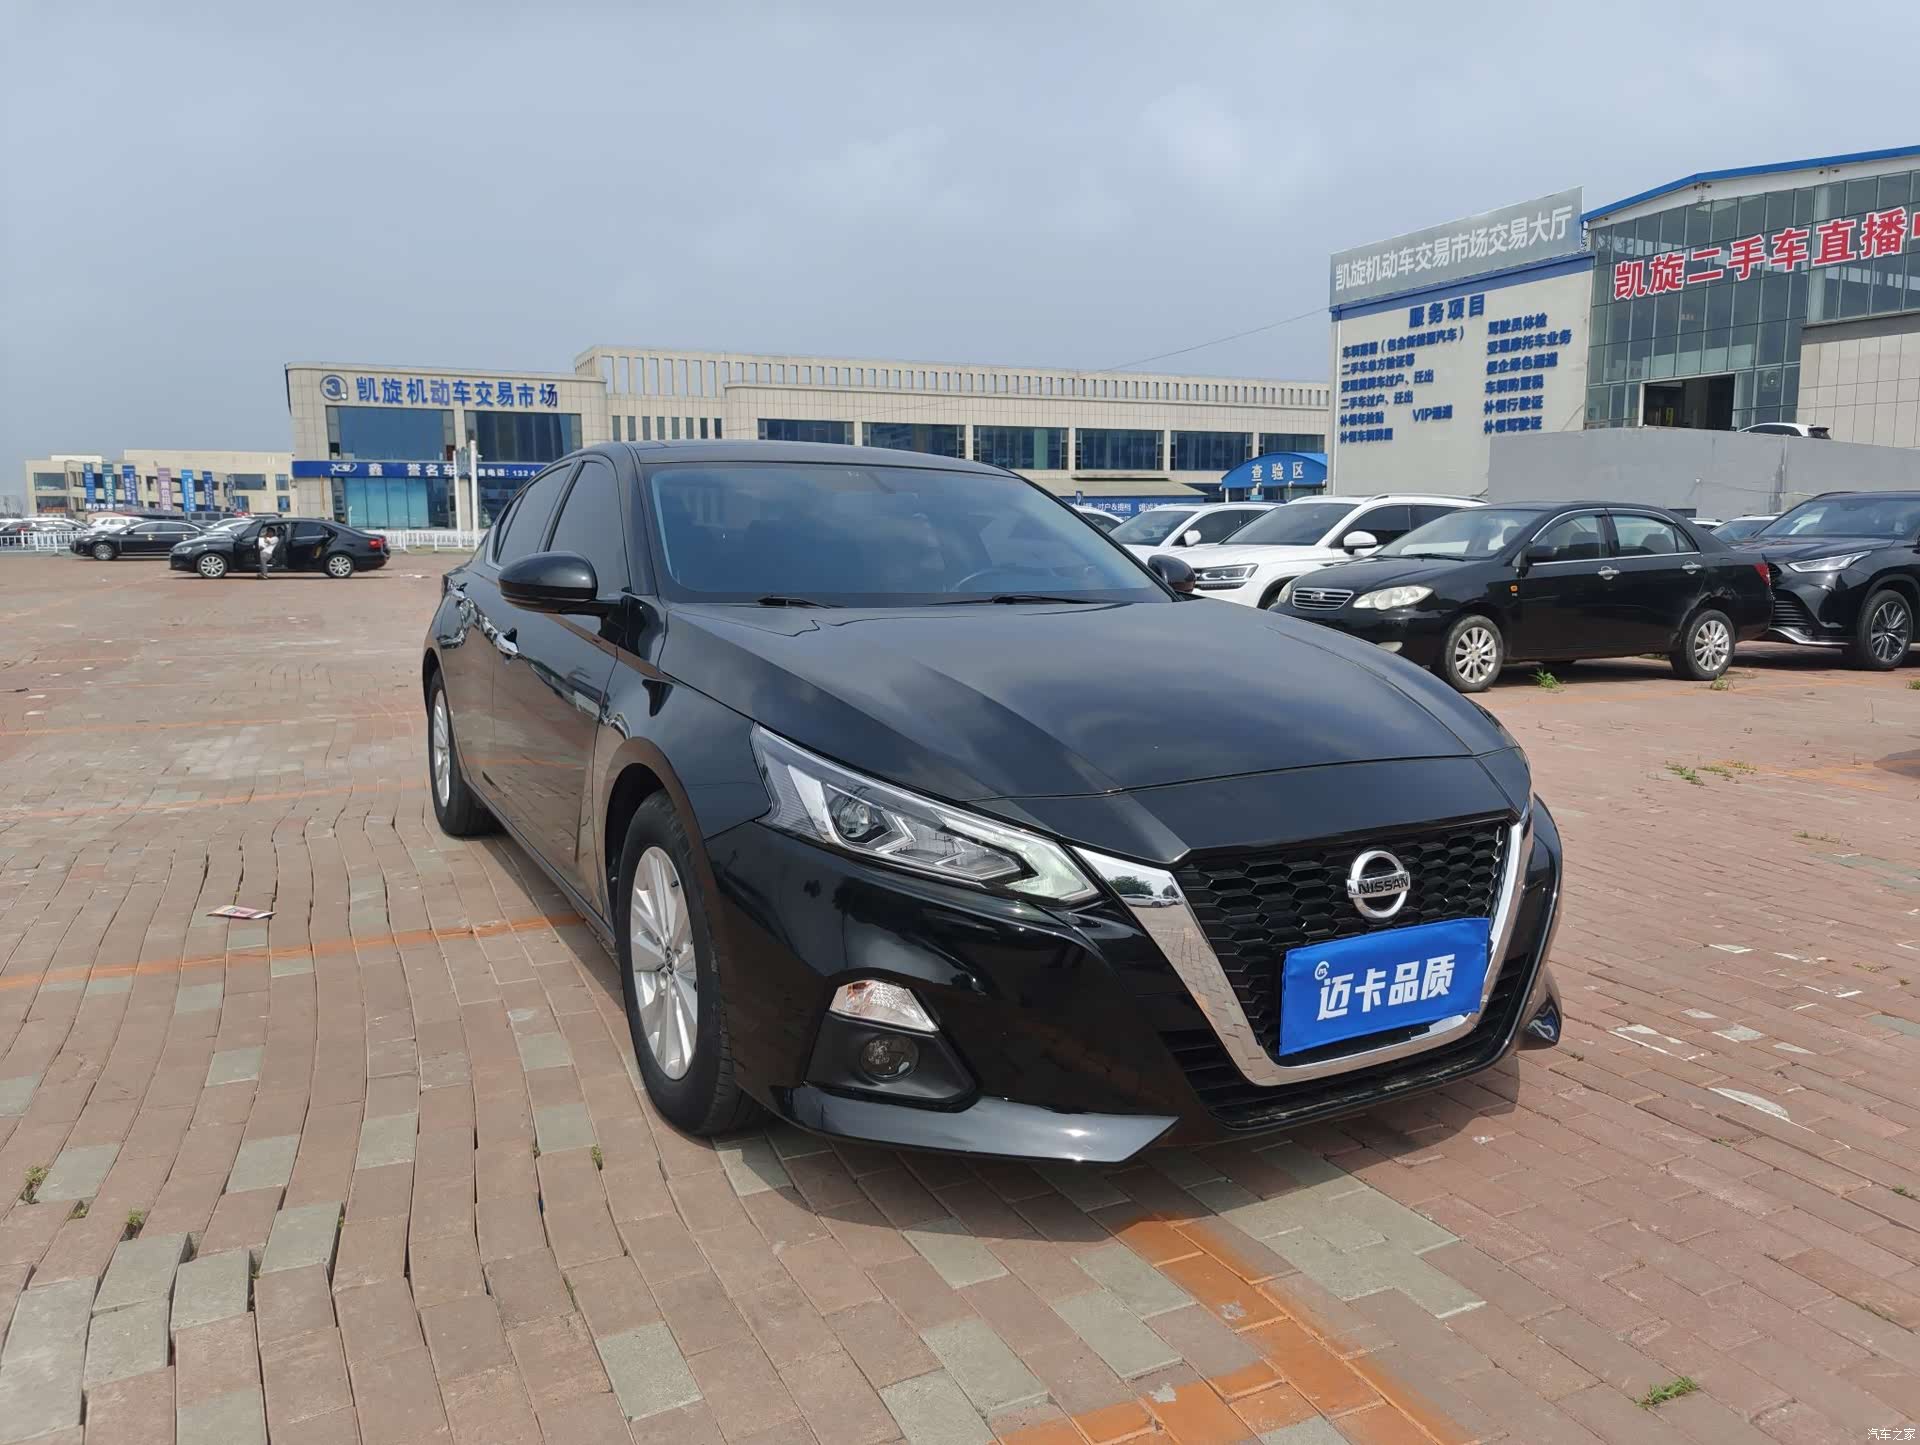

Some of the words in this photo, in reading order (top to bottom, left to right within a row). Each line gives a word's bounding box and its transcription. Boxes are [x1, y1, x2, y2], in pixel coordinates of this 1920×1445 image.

[1335, 205, 1573, 291] 凯旋机动车交易市场交易大厅
[1613, 206, 1920, 300] 凯旋二手车直播
[1409, 293, 1485, 328] 服务项目
[356, 376, 558, 408] 凯旋机动车交易市场
[1251, 462, 1304, 481] 查验区
[1358, 876, 1409, 894] NISSAN
[1316, 953, 1456, 1021] 迈卡品质
